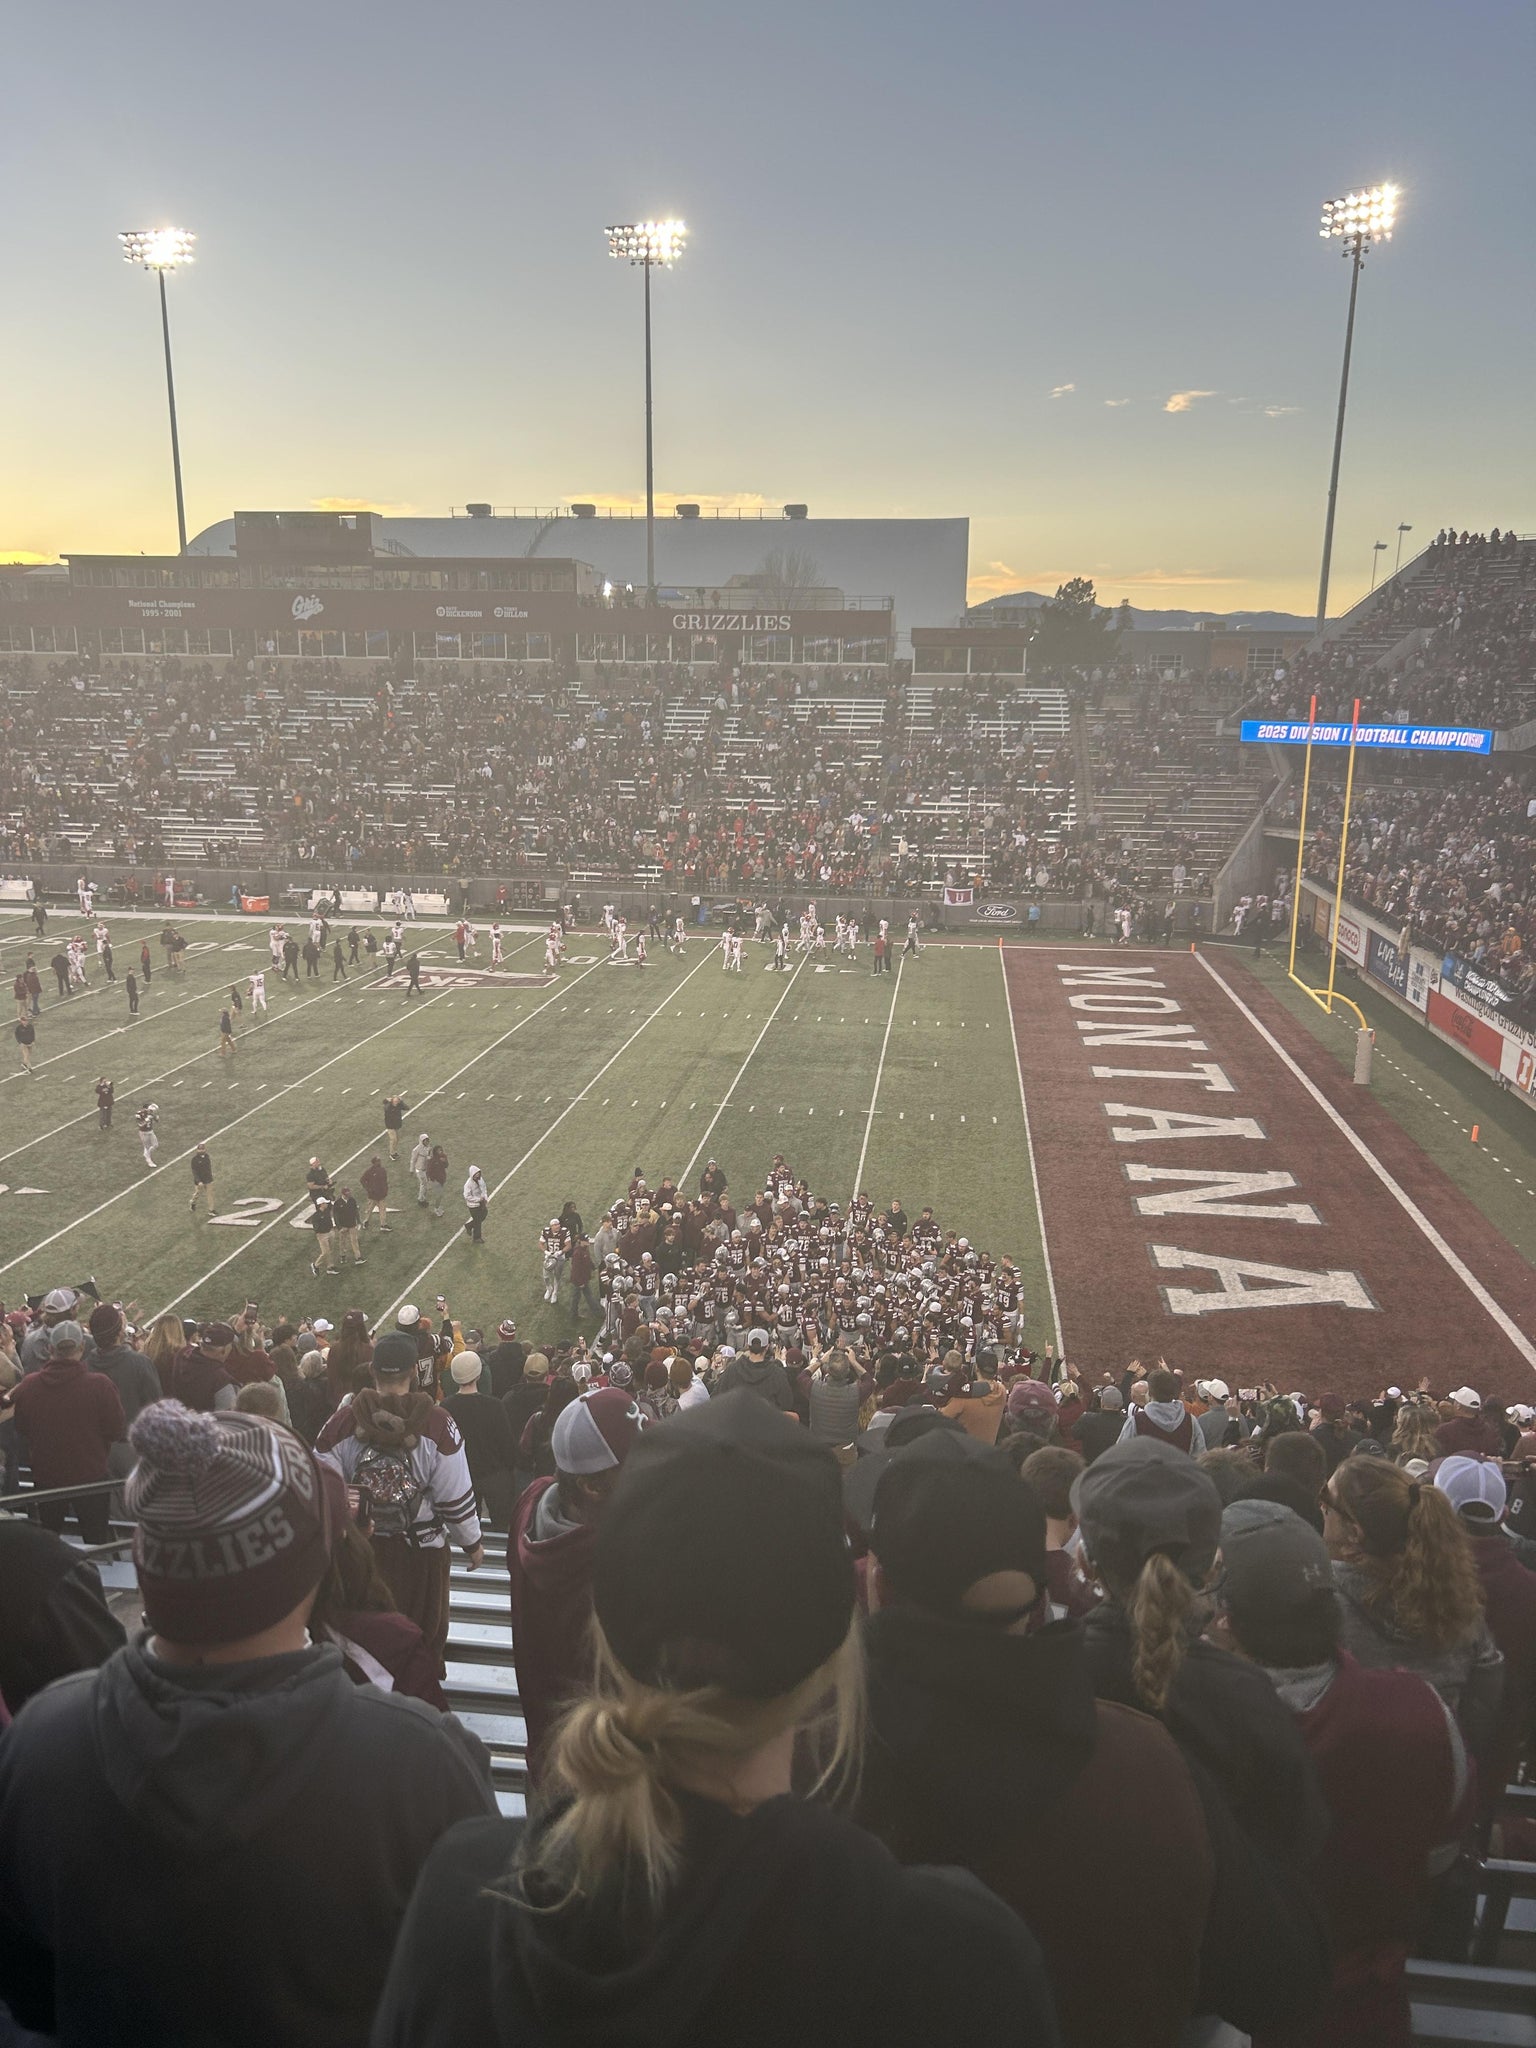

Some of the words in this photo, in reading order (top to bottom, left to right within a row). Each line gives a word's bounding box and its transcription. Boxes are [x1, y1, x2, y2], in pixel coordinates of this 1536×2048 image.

[128, 600, 157, 608] National
[159, 600, 196, 609] Champions
[142, 609, 160, 617] 1995
[164, 609, 182, 617] 2001
[672, 614, 792, 631] GRIZZLIES
[1257, 725, 1288, 739] 2025
[1289, 726, 1340, 741] DIVSION
[984, 905, 1009, 917] Ford
[1057, 964, 1375, 1315] MONTANA
